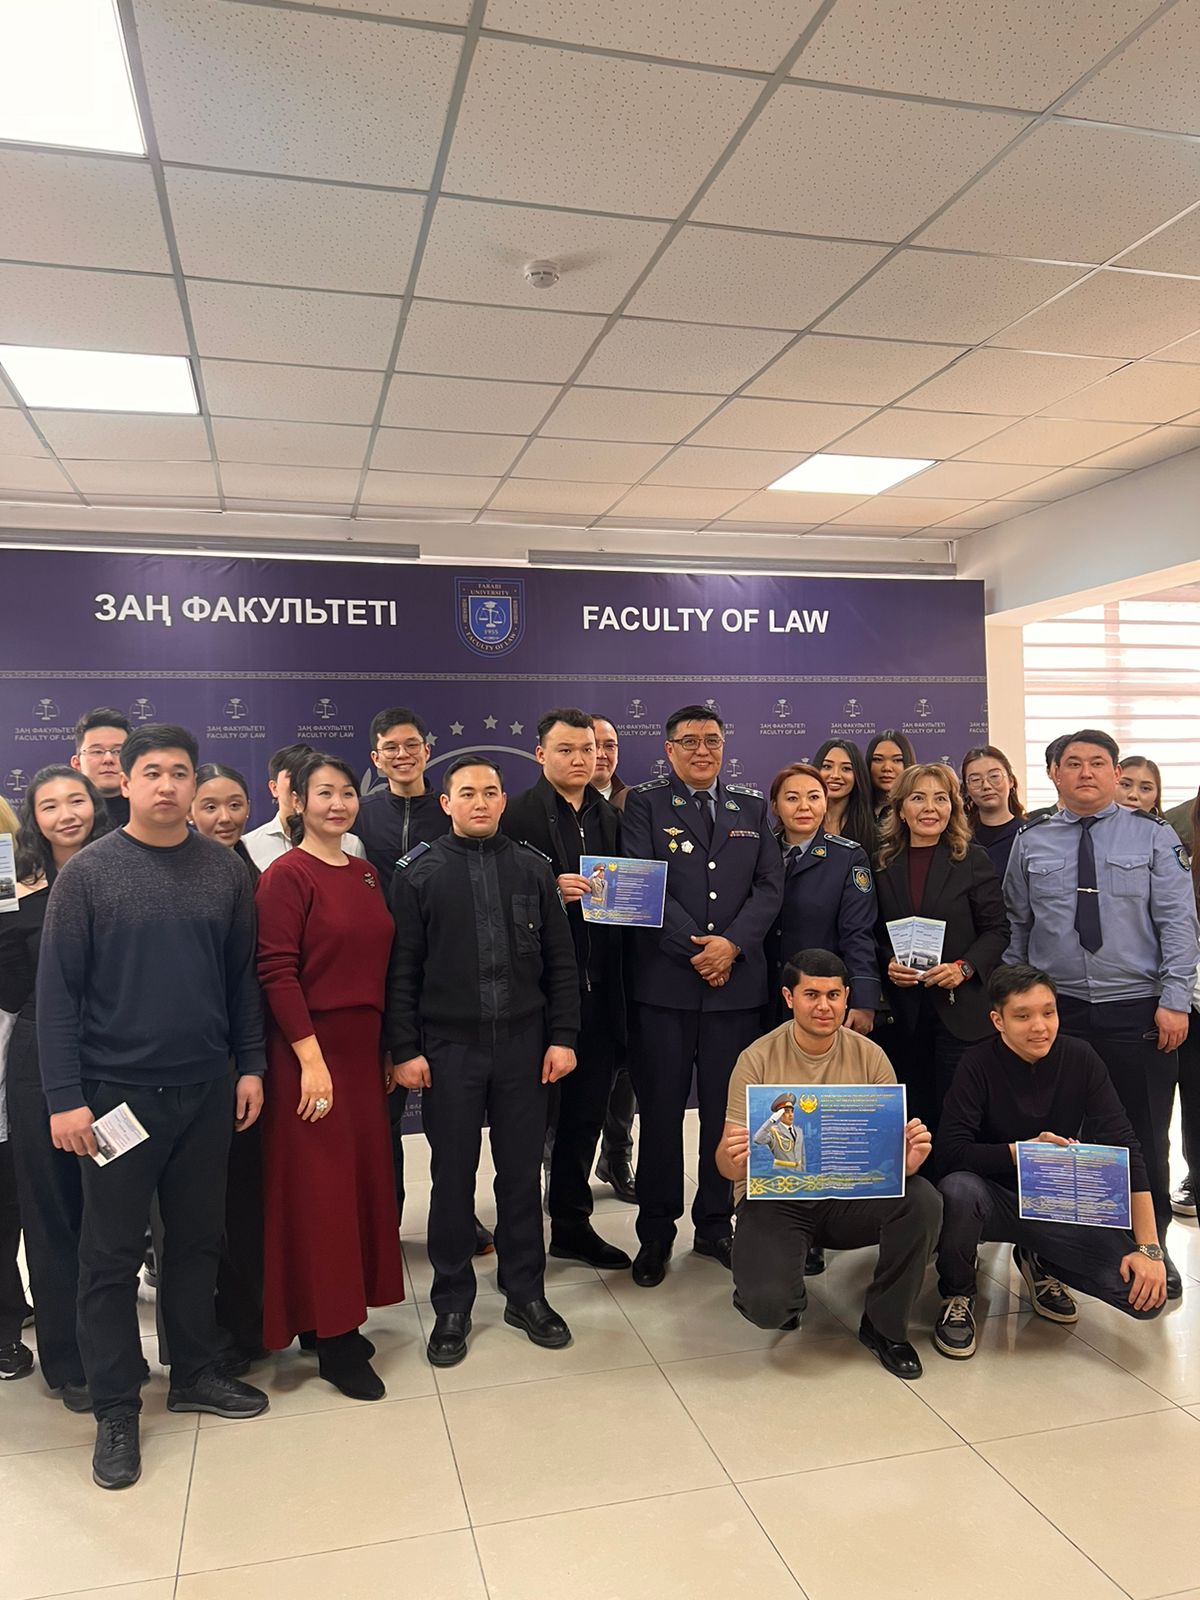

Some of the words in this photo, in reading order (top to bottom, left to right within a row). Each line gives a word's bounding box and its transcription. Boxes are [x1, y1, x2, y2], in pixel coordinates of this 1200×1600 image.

[94, 593, 172, 626] ЗАҢ
[181, 596, 397, 625] ФАКУЛЬТЕТІ
[583, 605, 714, 632] FACULTY
[721, 608, 760, 633] OF
[769, 609, 829, 633] LAW
[466, 631, 494, 651] FACULTY
[503, 633, 516, 646] LAW
